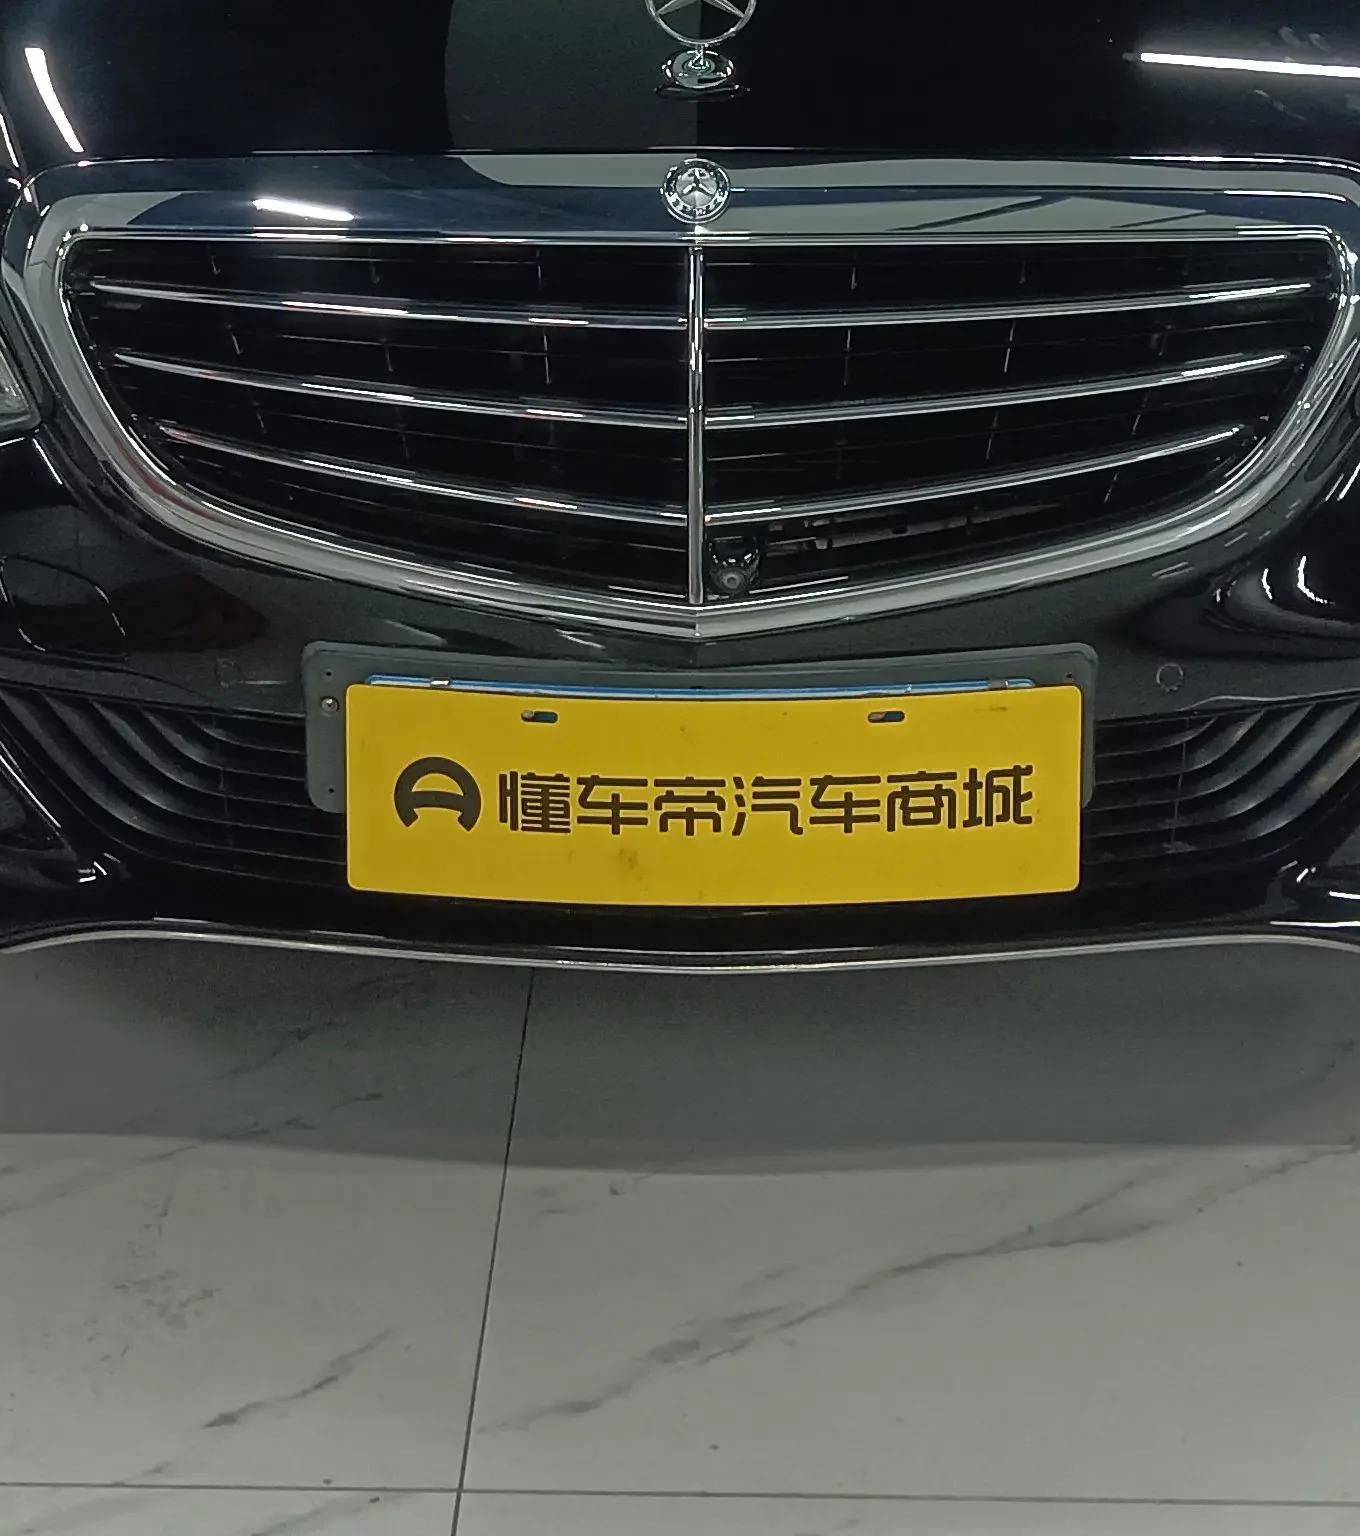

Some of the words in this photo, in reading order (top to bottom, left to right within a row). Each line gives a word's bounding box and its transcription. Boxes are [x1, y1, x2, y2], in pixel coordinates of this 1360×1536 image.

[498, 763, 1035, 837] 懂车帝汽车商城
